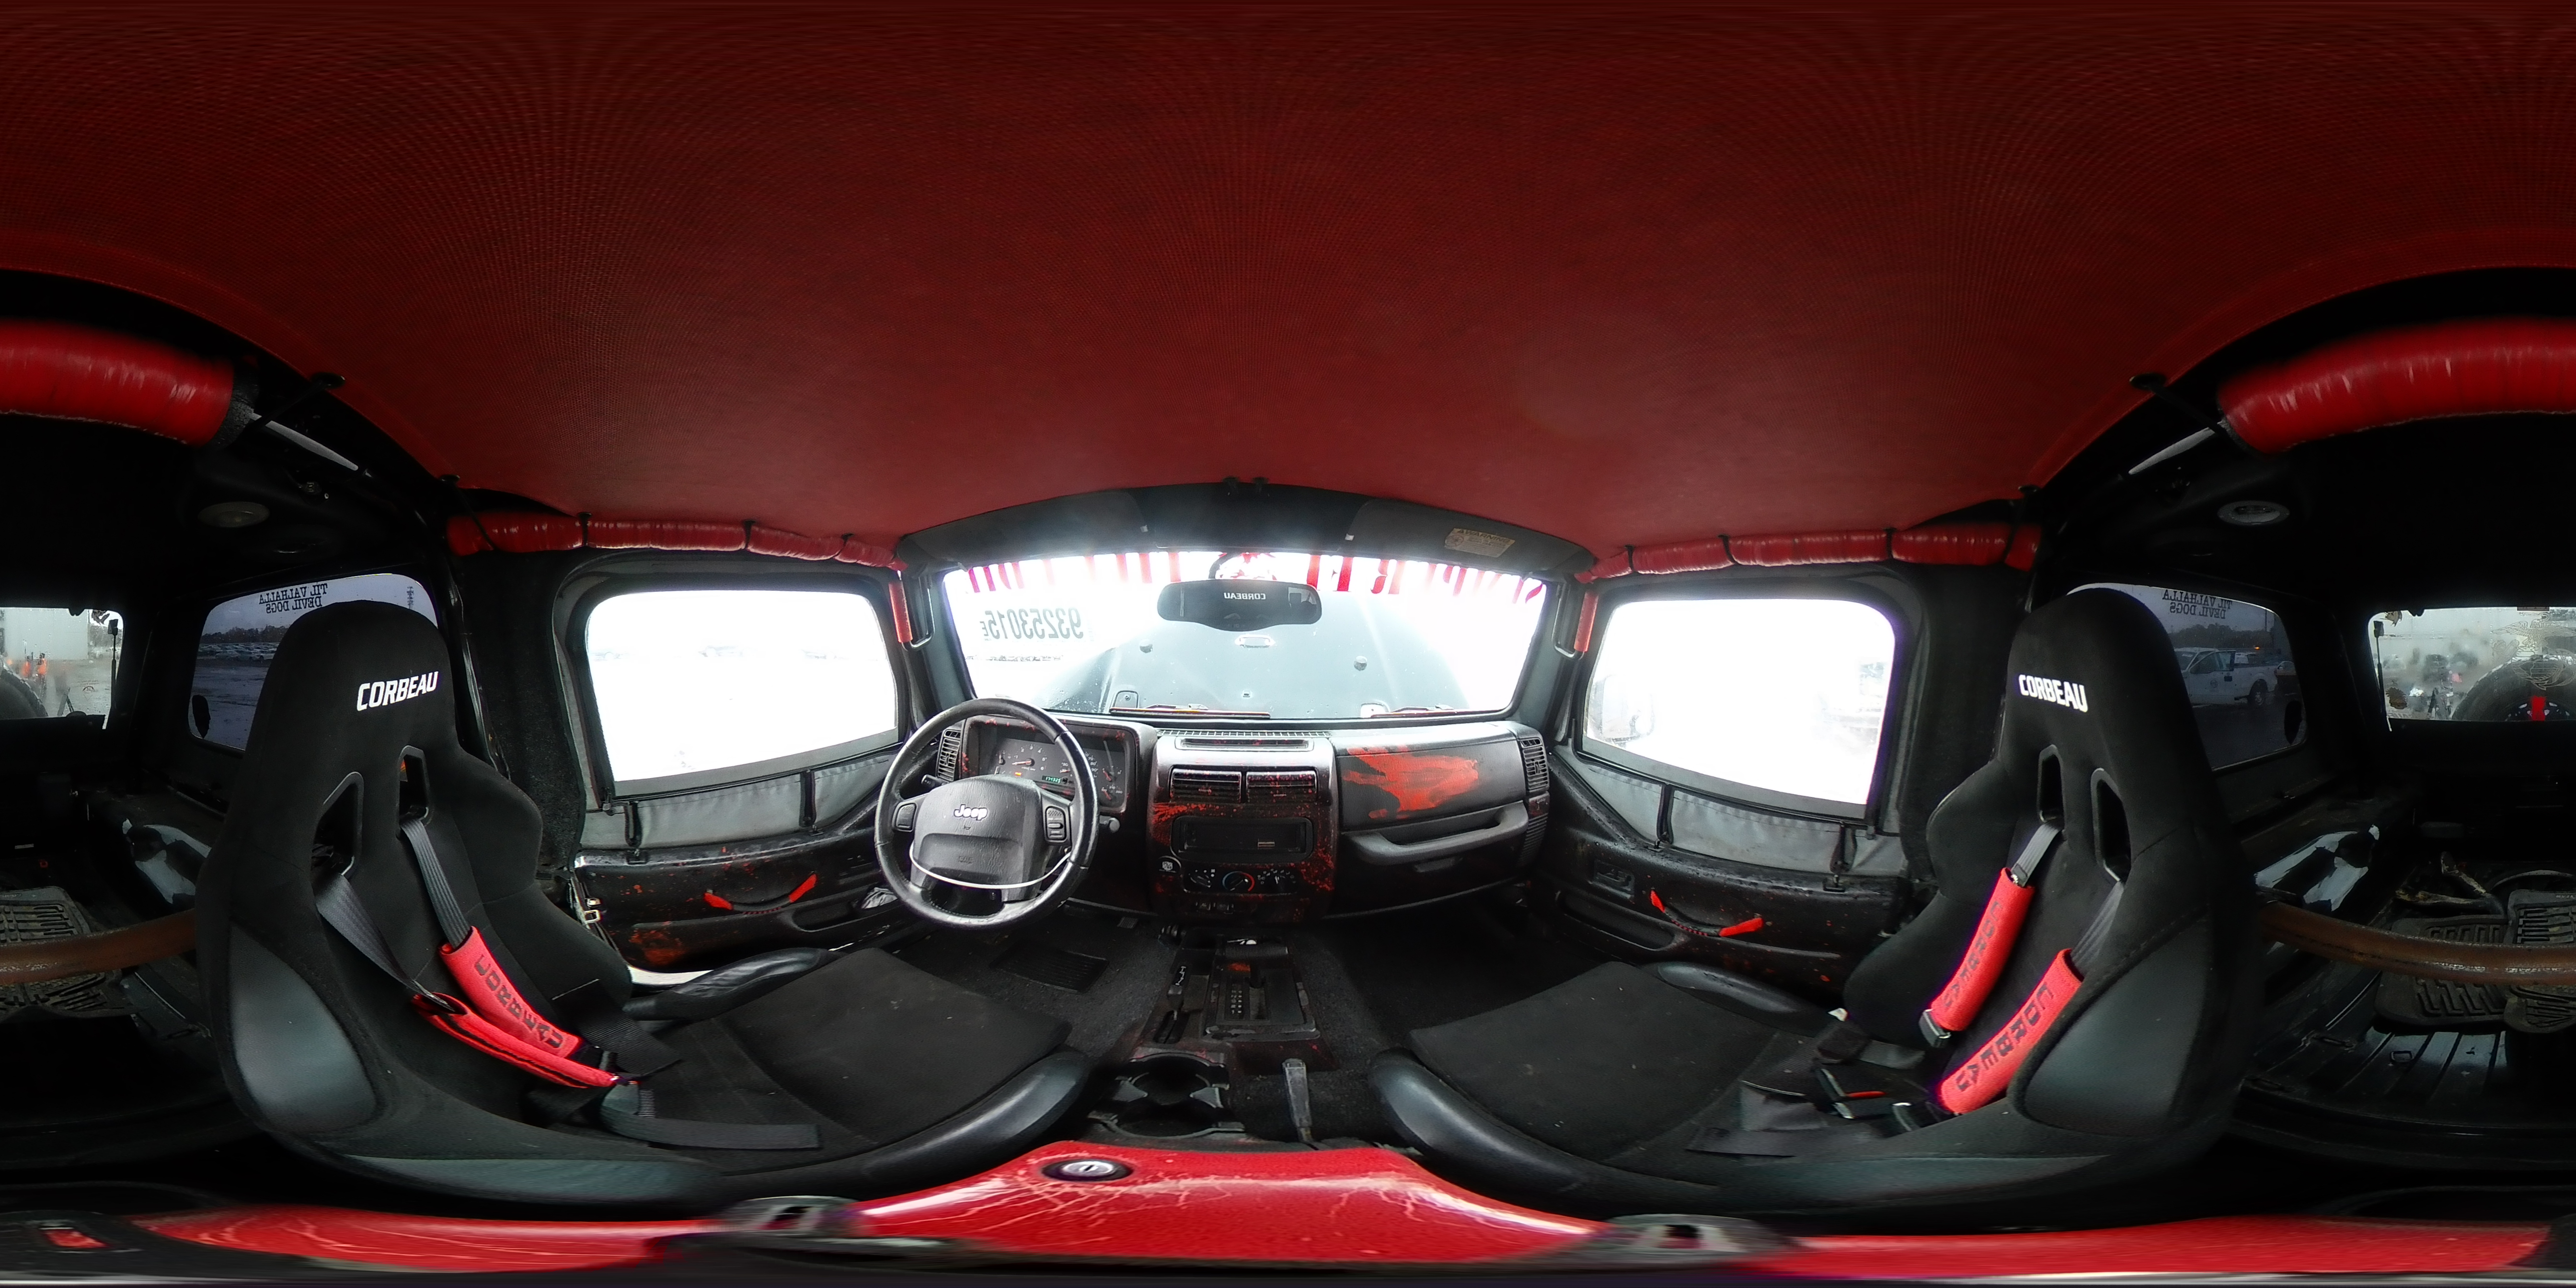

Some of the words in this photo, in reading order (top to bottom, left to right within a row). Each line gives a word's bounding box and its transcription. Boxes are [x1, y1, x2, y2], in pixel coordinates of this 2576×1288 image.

[1465, 530, 1511, 543] WARNING
[357, 671, 438, 711] CORBEAU
[2019, 674, 2088, 713] CORBEAU
[954, 804, 988, 821] Jeep
[1942, 901, 2003, 1008] CORBEAU
[474, 954, 564, 1048] CORBEAU
[1955, 983, 2053, 1092] CORBEAU
